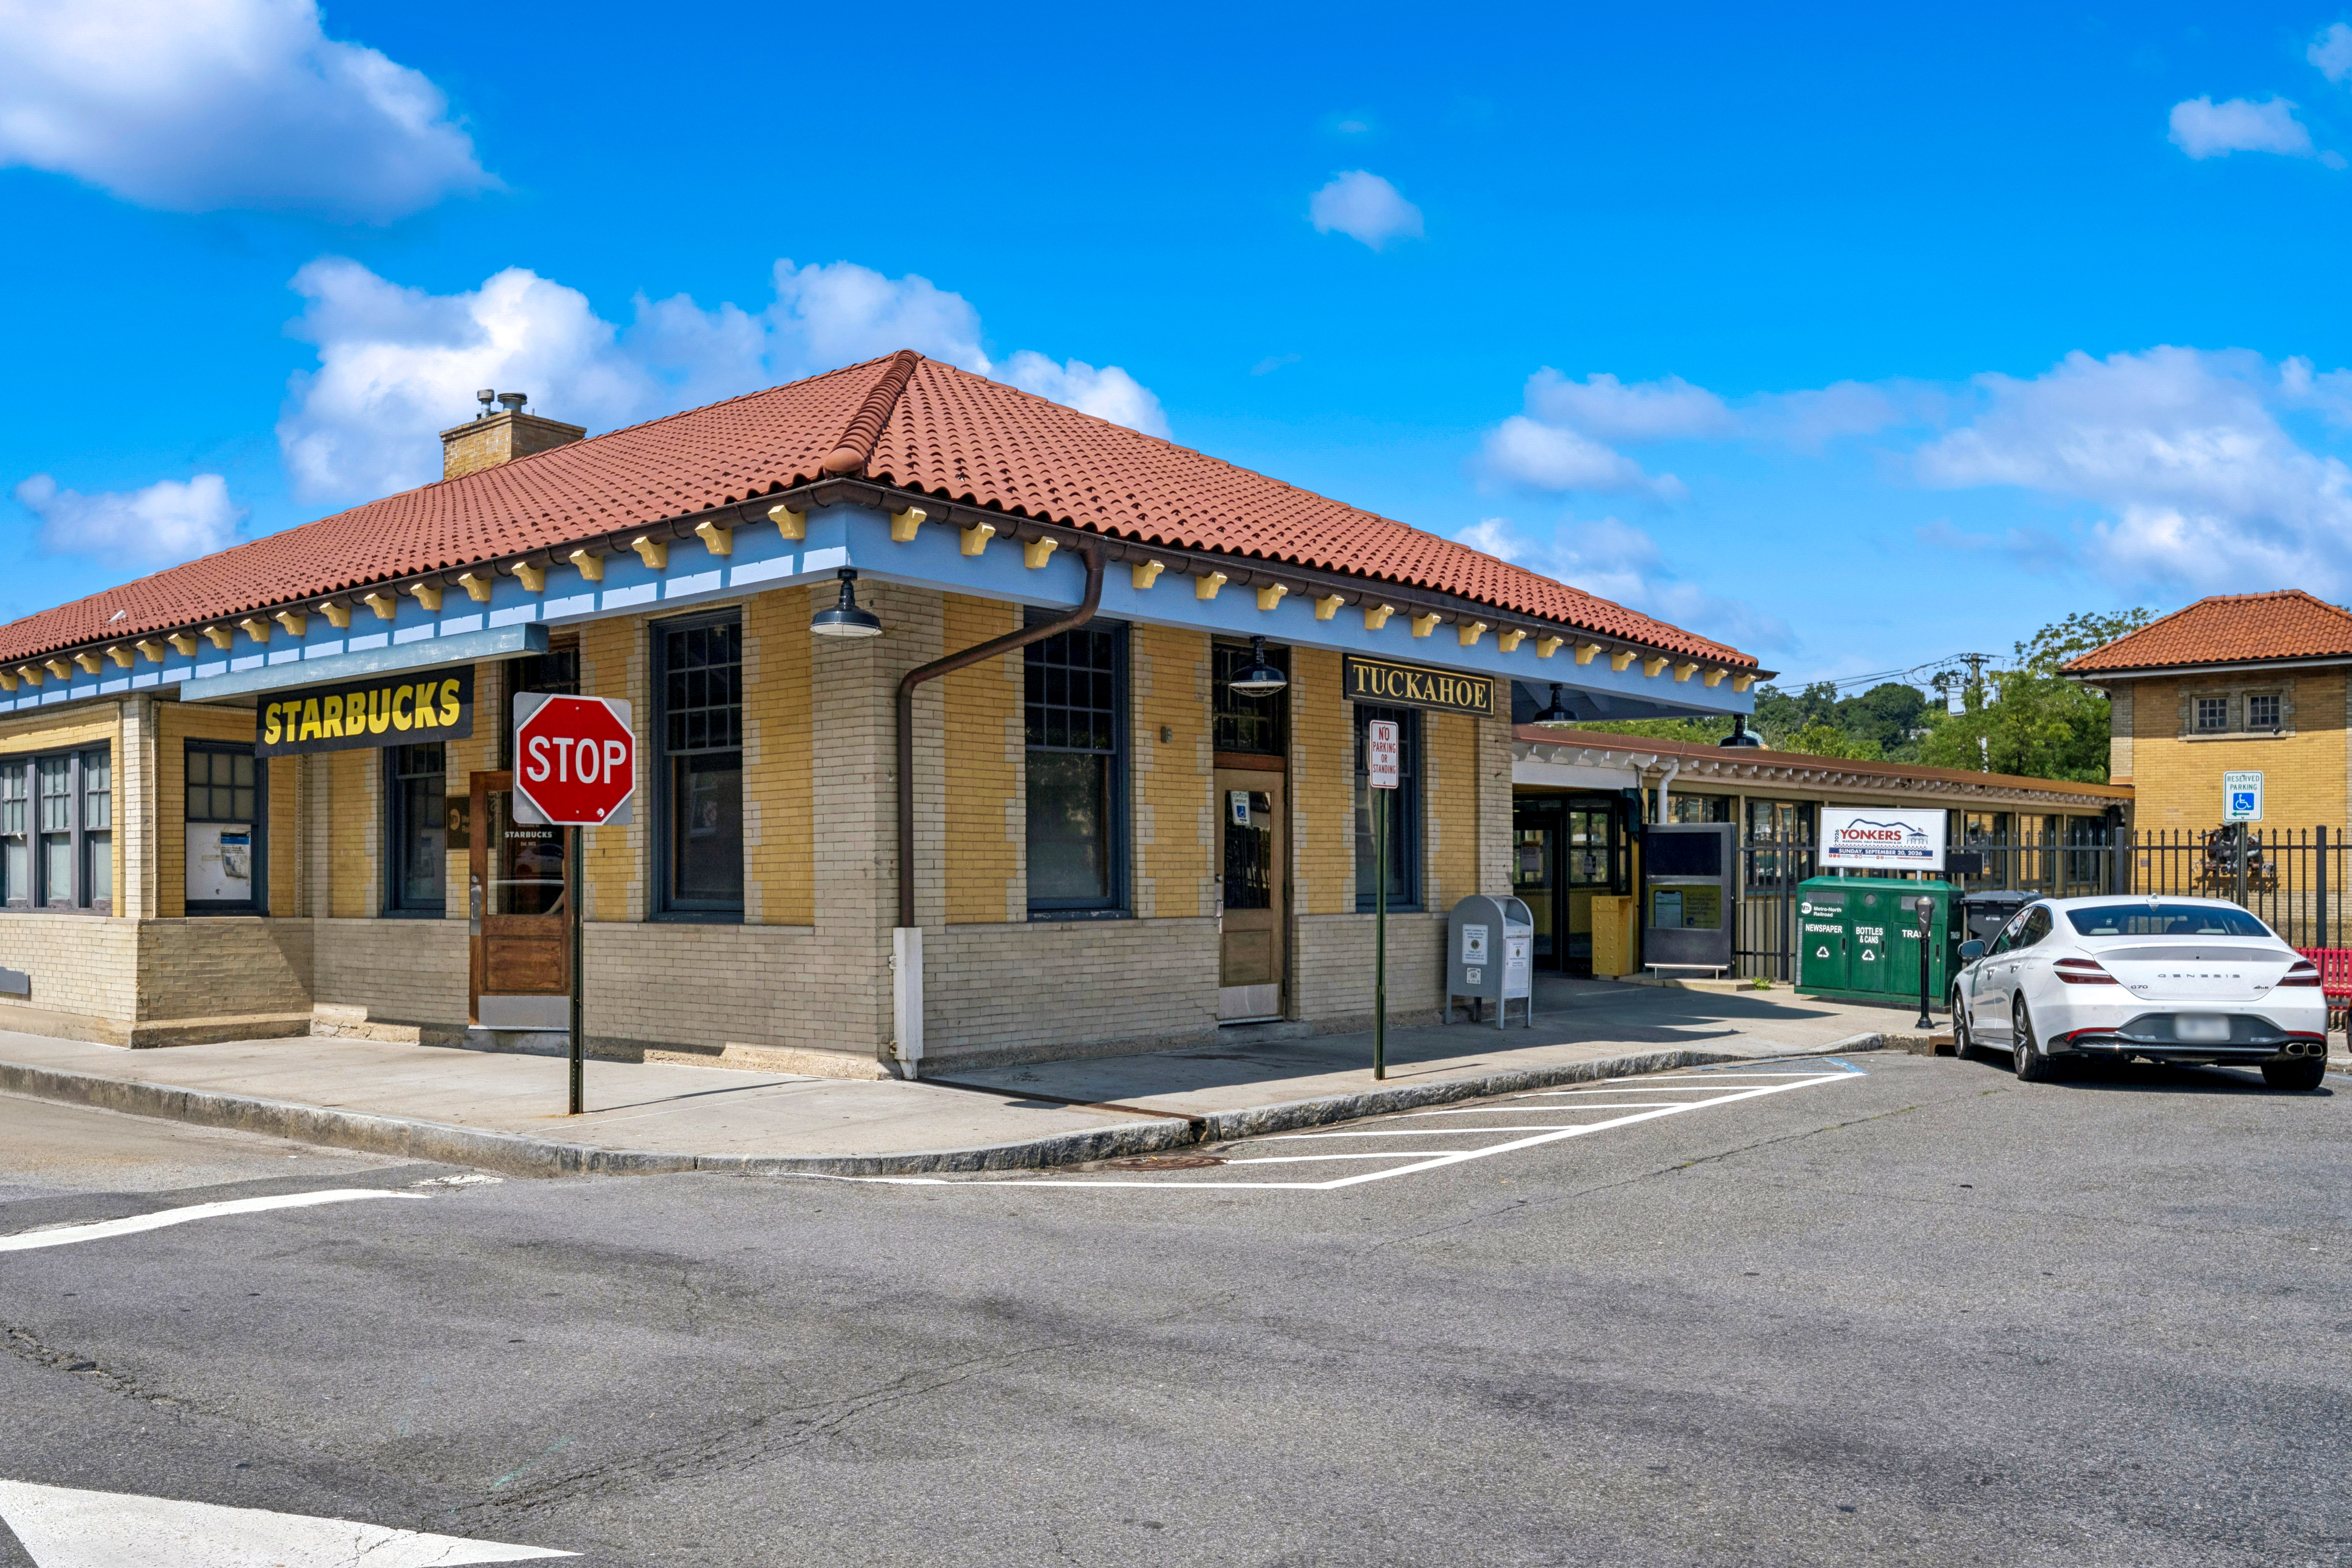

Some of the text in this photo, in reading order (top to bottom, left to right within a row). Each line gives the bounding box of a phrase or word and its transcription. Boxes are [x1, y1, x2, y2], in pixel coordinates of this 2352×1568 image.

[1353, 664, 1486, 708] TUCKAHOE
[264, 678, 460, 745] STARBUCKS
[1378, 727, 1390, 741] NO
[1373, 741, 1396, 754] PARKING
[526, 735, 627, 784] STOP
[1381, 754, 1388, 763] OR
[1373, 764, 1396, 774] STANDING
[1840, 829, 1902, 841] YONKERS
[1805, 923, 1843, 933] NEWSPAPER
[1855, 926, 1883, 936] BOTTLES
[1859, 935, 1879, 944] & CANS
[1950, 931, 1961, 939] TRASH
